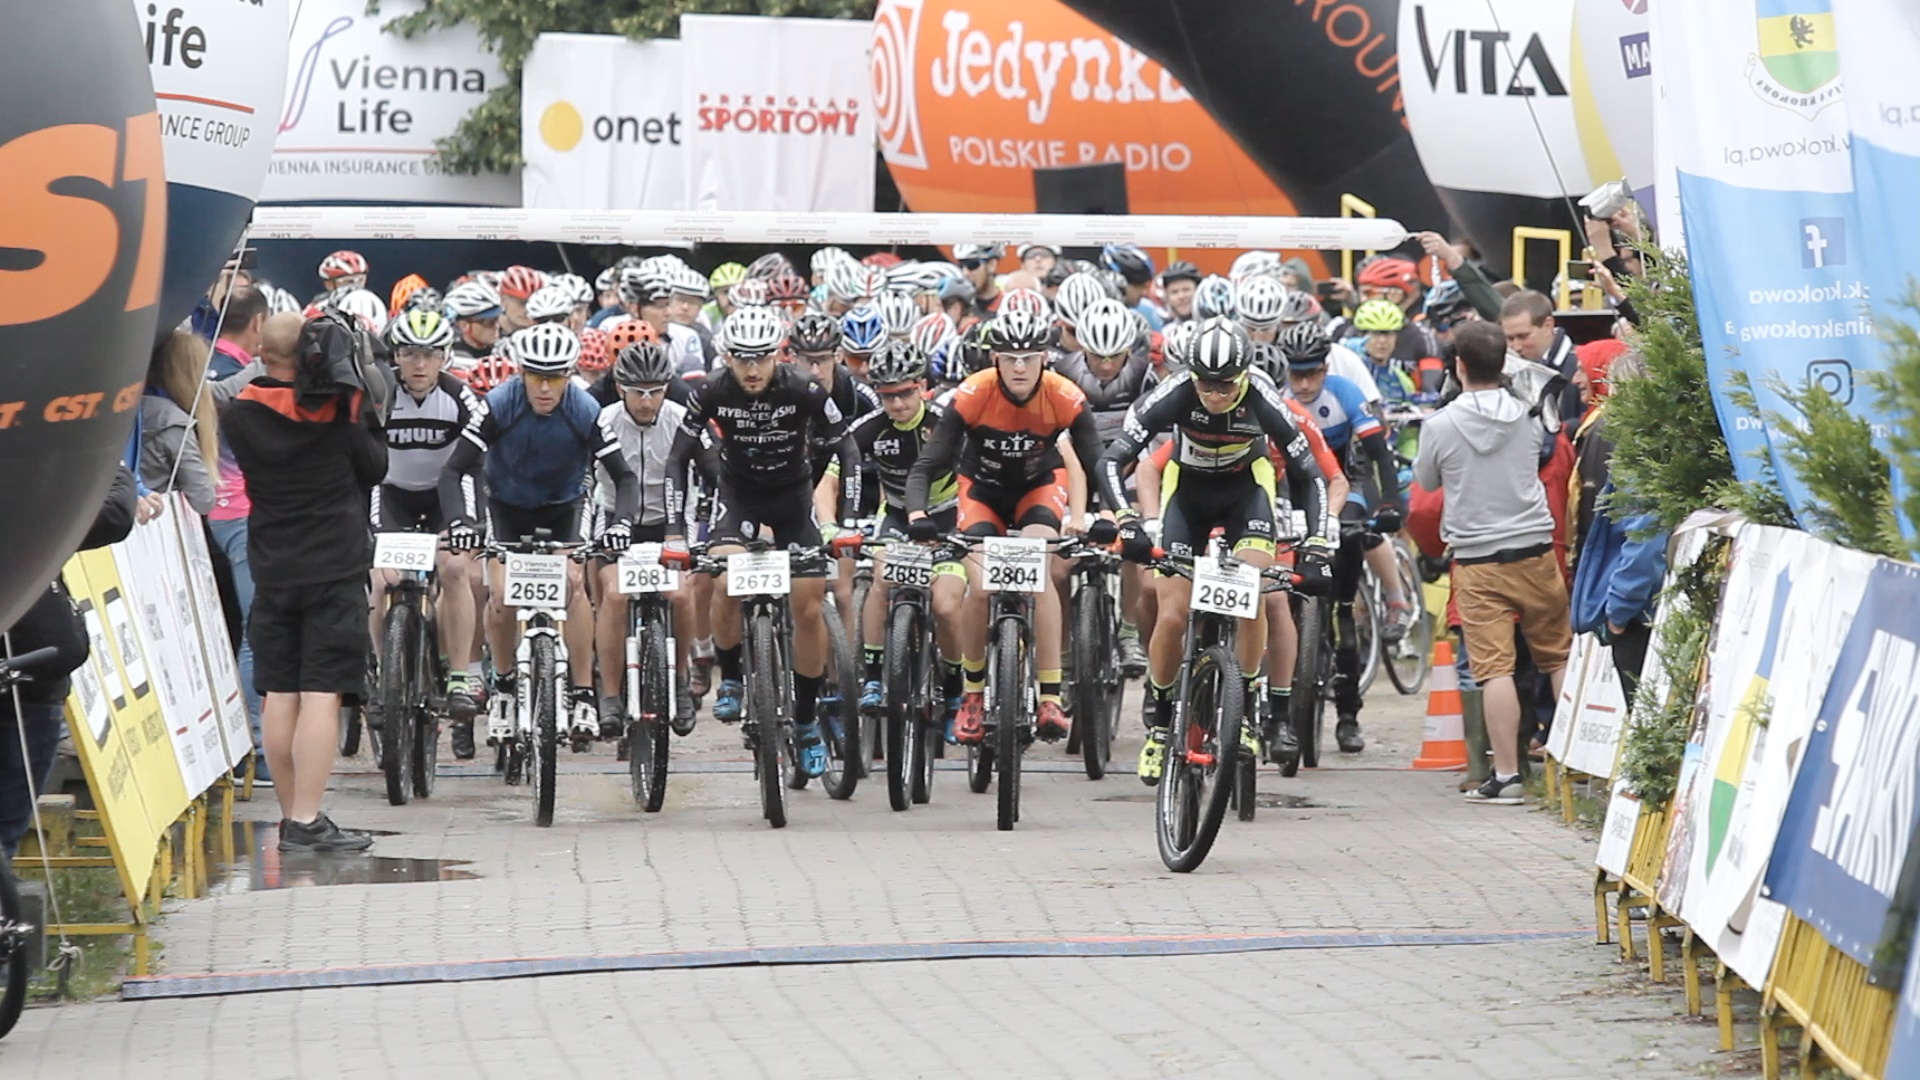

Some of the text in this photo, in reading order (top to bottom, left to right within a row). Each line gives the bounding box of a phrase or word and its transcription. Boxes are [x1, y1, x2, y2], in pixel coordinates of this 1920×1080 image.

[146, 3, 207, 69] ife
[1414, 5, 1569, 96] VITA
[330, 54, 485, 93] Vienna
[338, 98, 413, 133] Life
[593, 111, 682, 145] onet
[698, 107, 859, 136] SPORTOWY
[203, 119, 251, 149] GROUP
[949, 136, 1192, 172] POLSKIE RADIO
[323, 160, 421, 176] INSURANCE
[386, 428, 449, 444] THULE
[381, 551, 428, 566] 2682
[625, 569, 672, 587] 2681
[735, 573, 783, 590] 2673
[883, 563, 931, 585] 2685
[989, 566, 1039, 586] 2804
[511, 582, 560, 601] 2652
[1199, 585, 1251, 611] 2684
